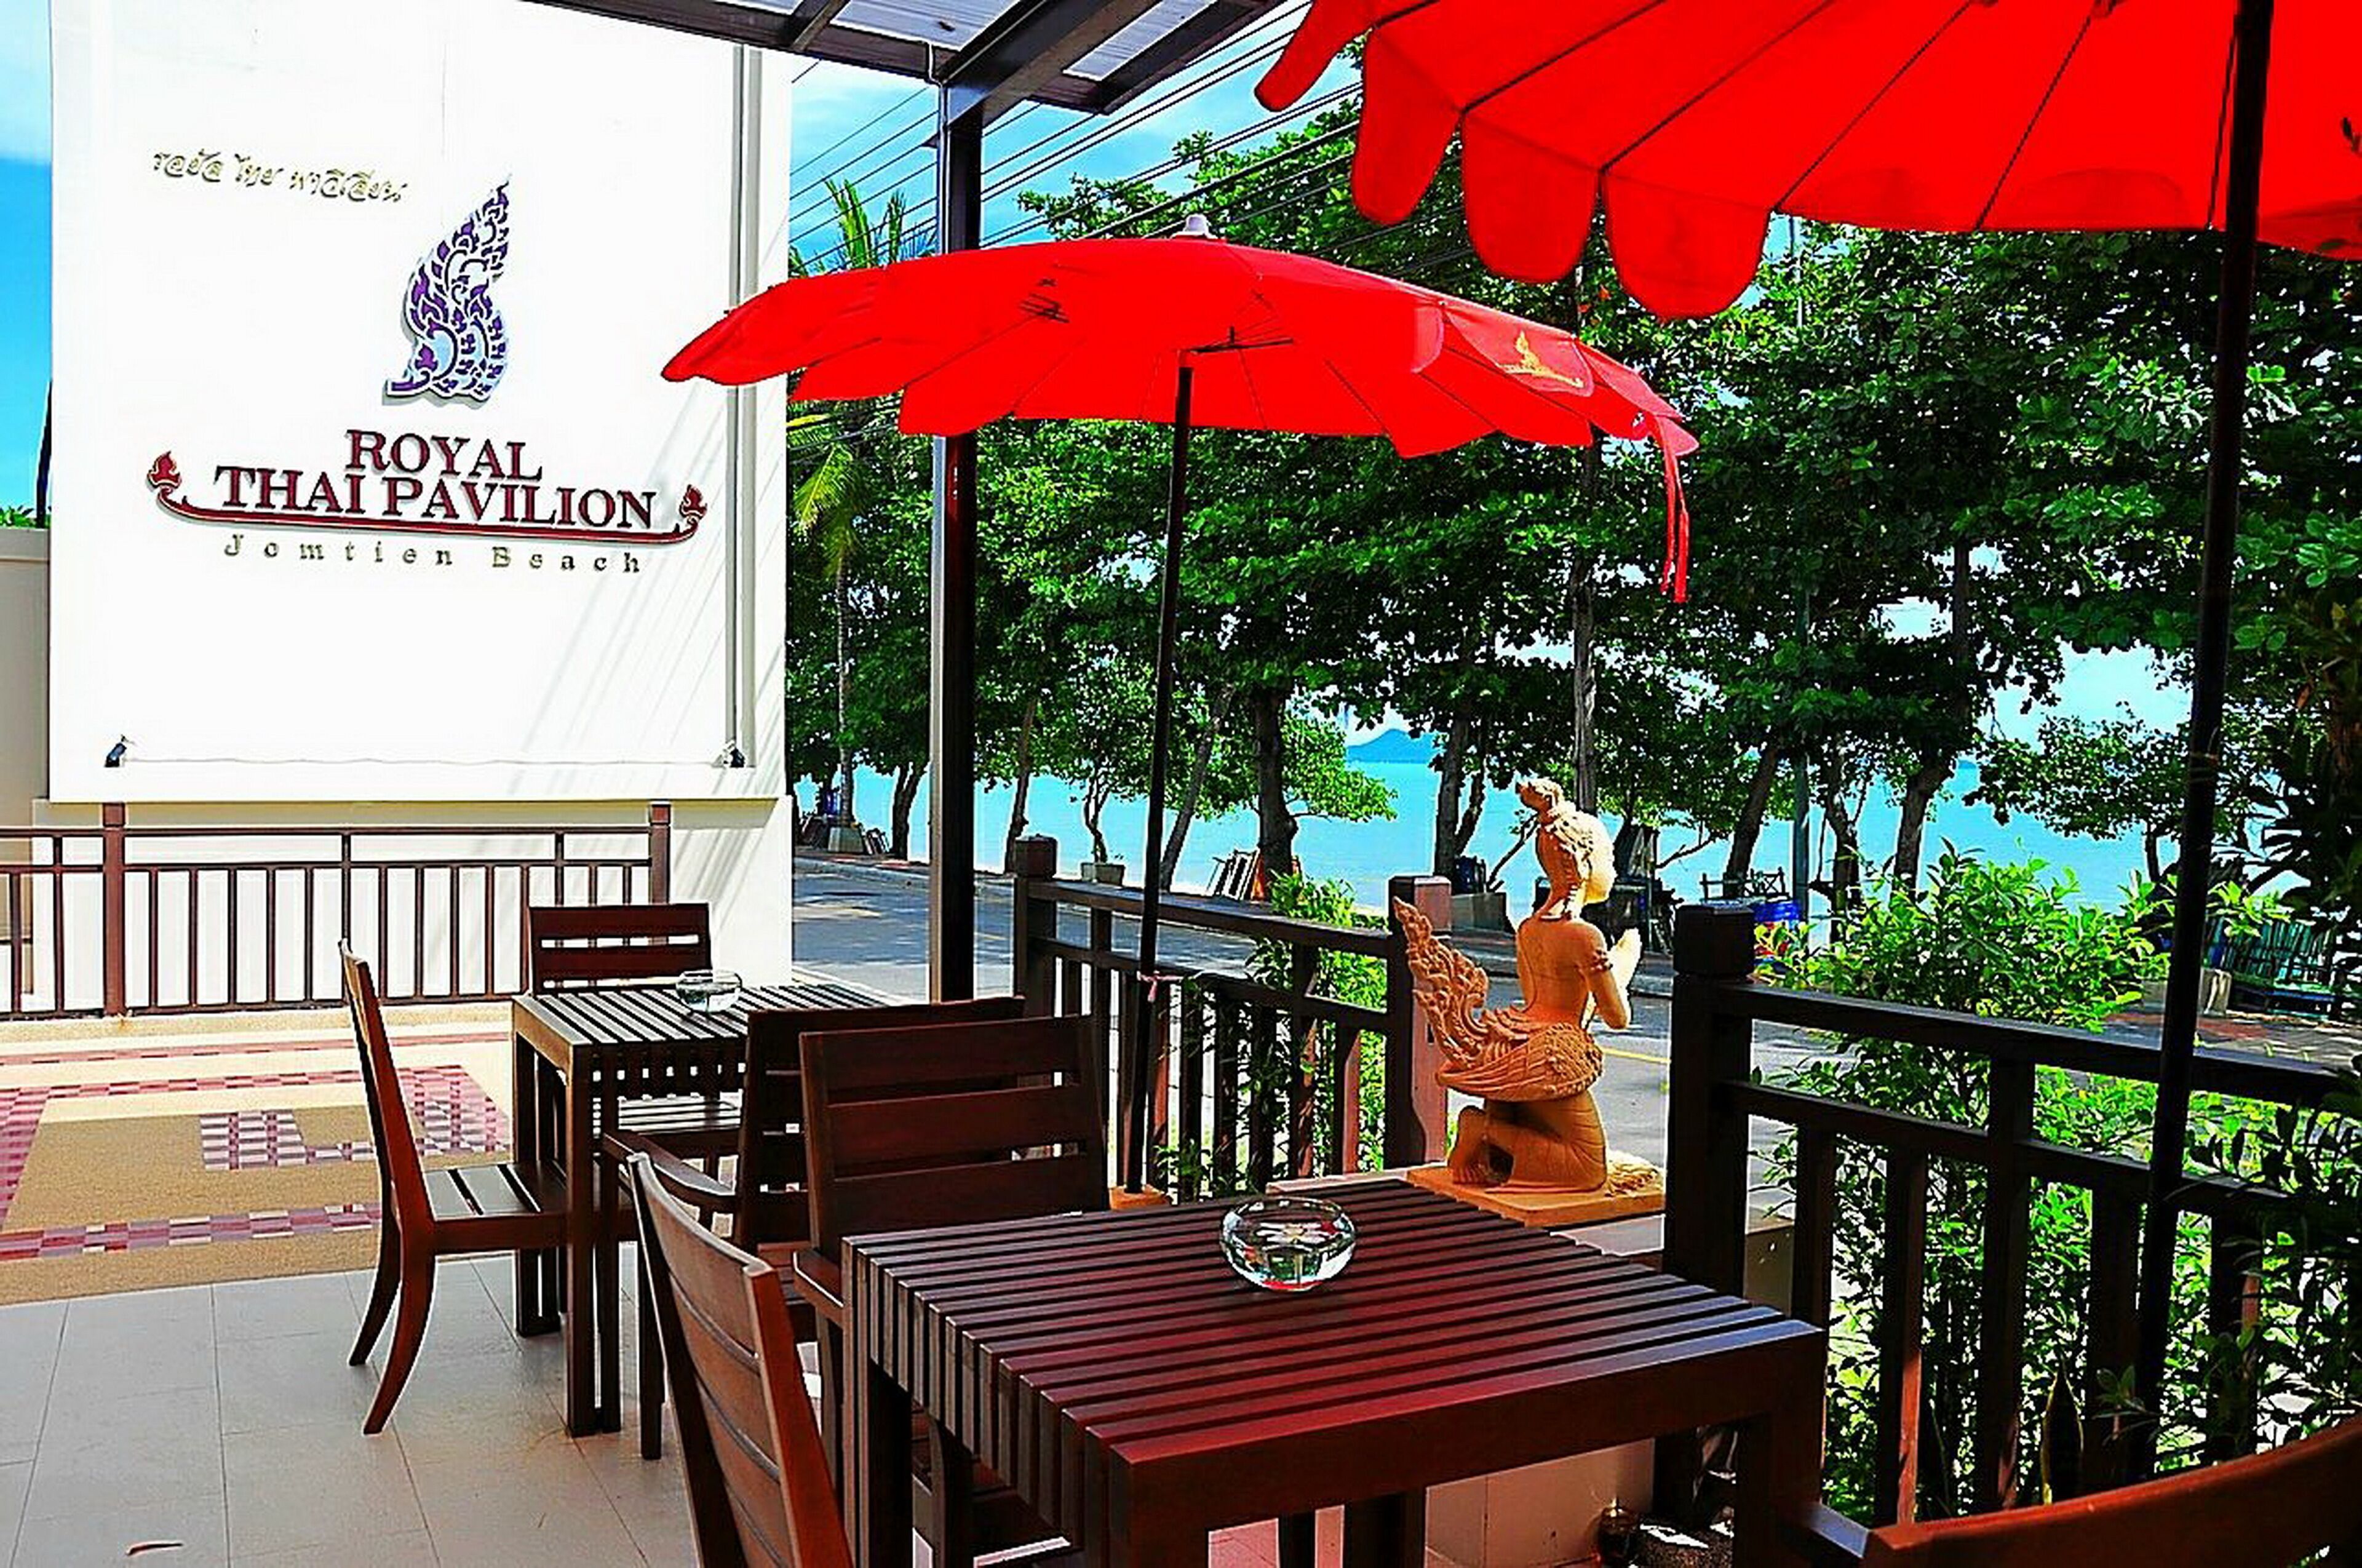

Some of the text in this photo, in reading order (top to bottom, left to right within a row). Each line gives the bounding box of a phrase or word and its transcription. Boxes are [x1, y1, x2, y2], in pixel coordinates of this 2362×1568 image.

[154, 149, 223, 183] รอยัล
[234, 153, 284, 187] ไทย
[344, 429, 543, 482] ROYAL
[214, 465, 657, 530] THAI PAVILION
[224, 533, 641, 573] Jomtien Beach
